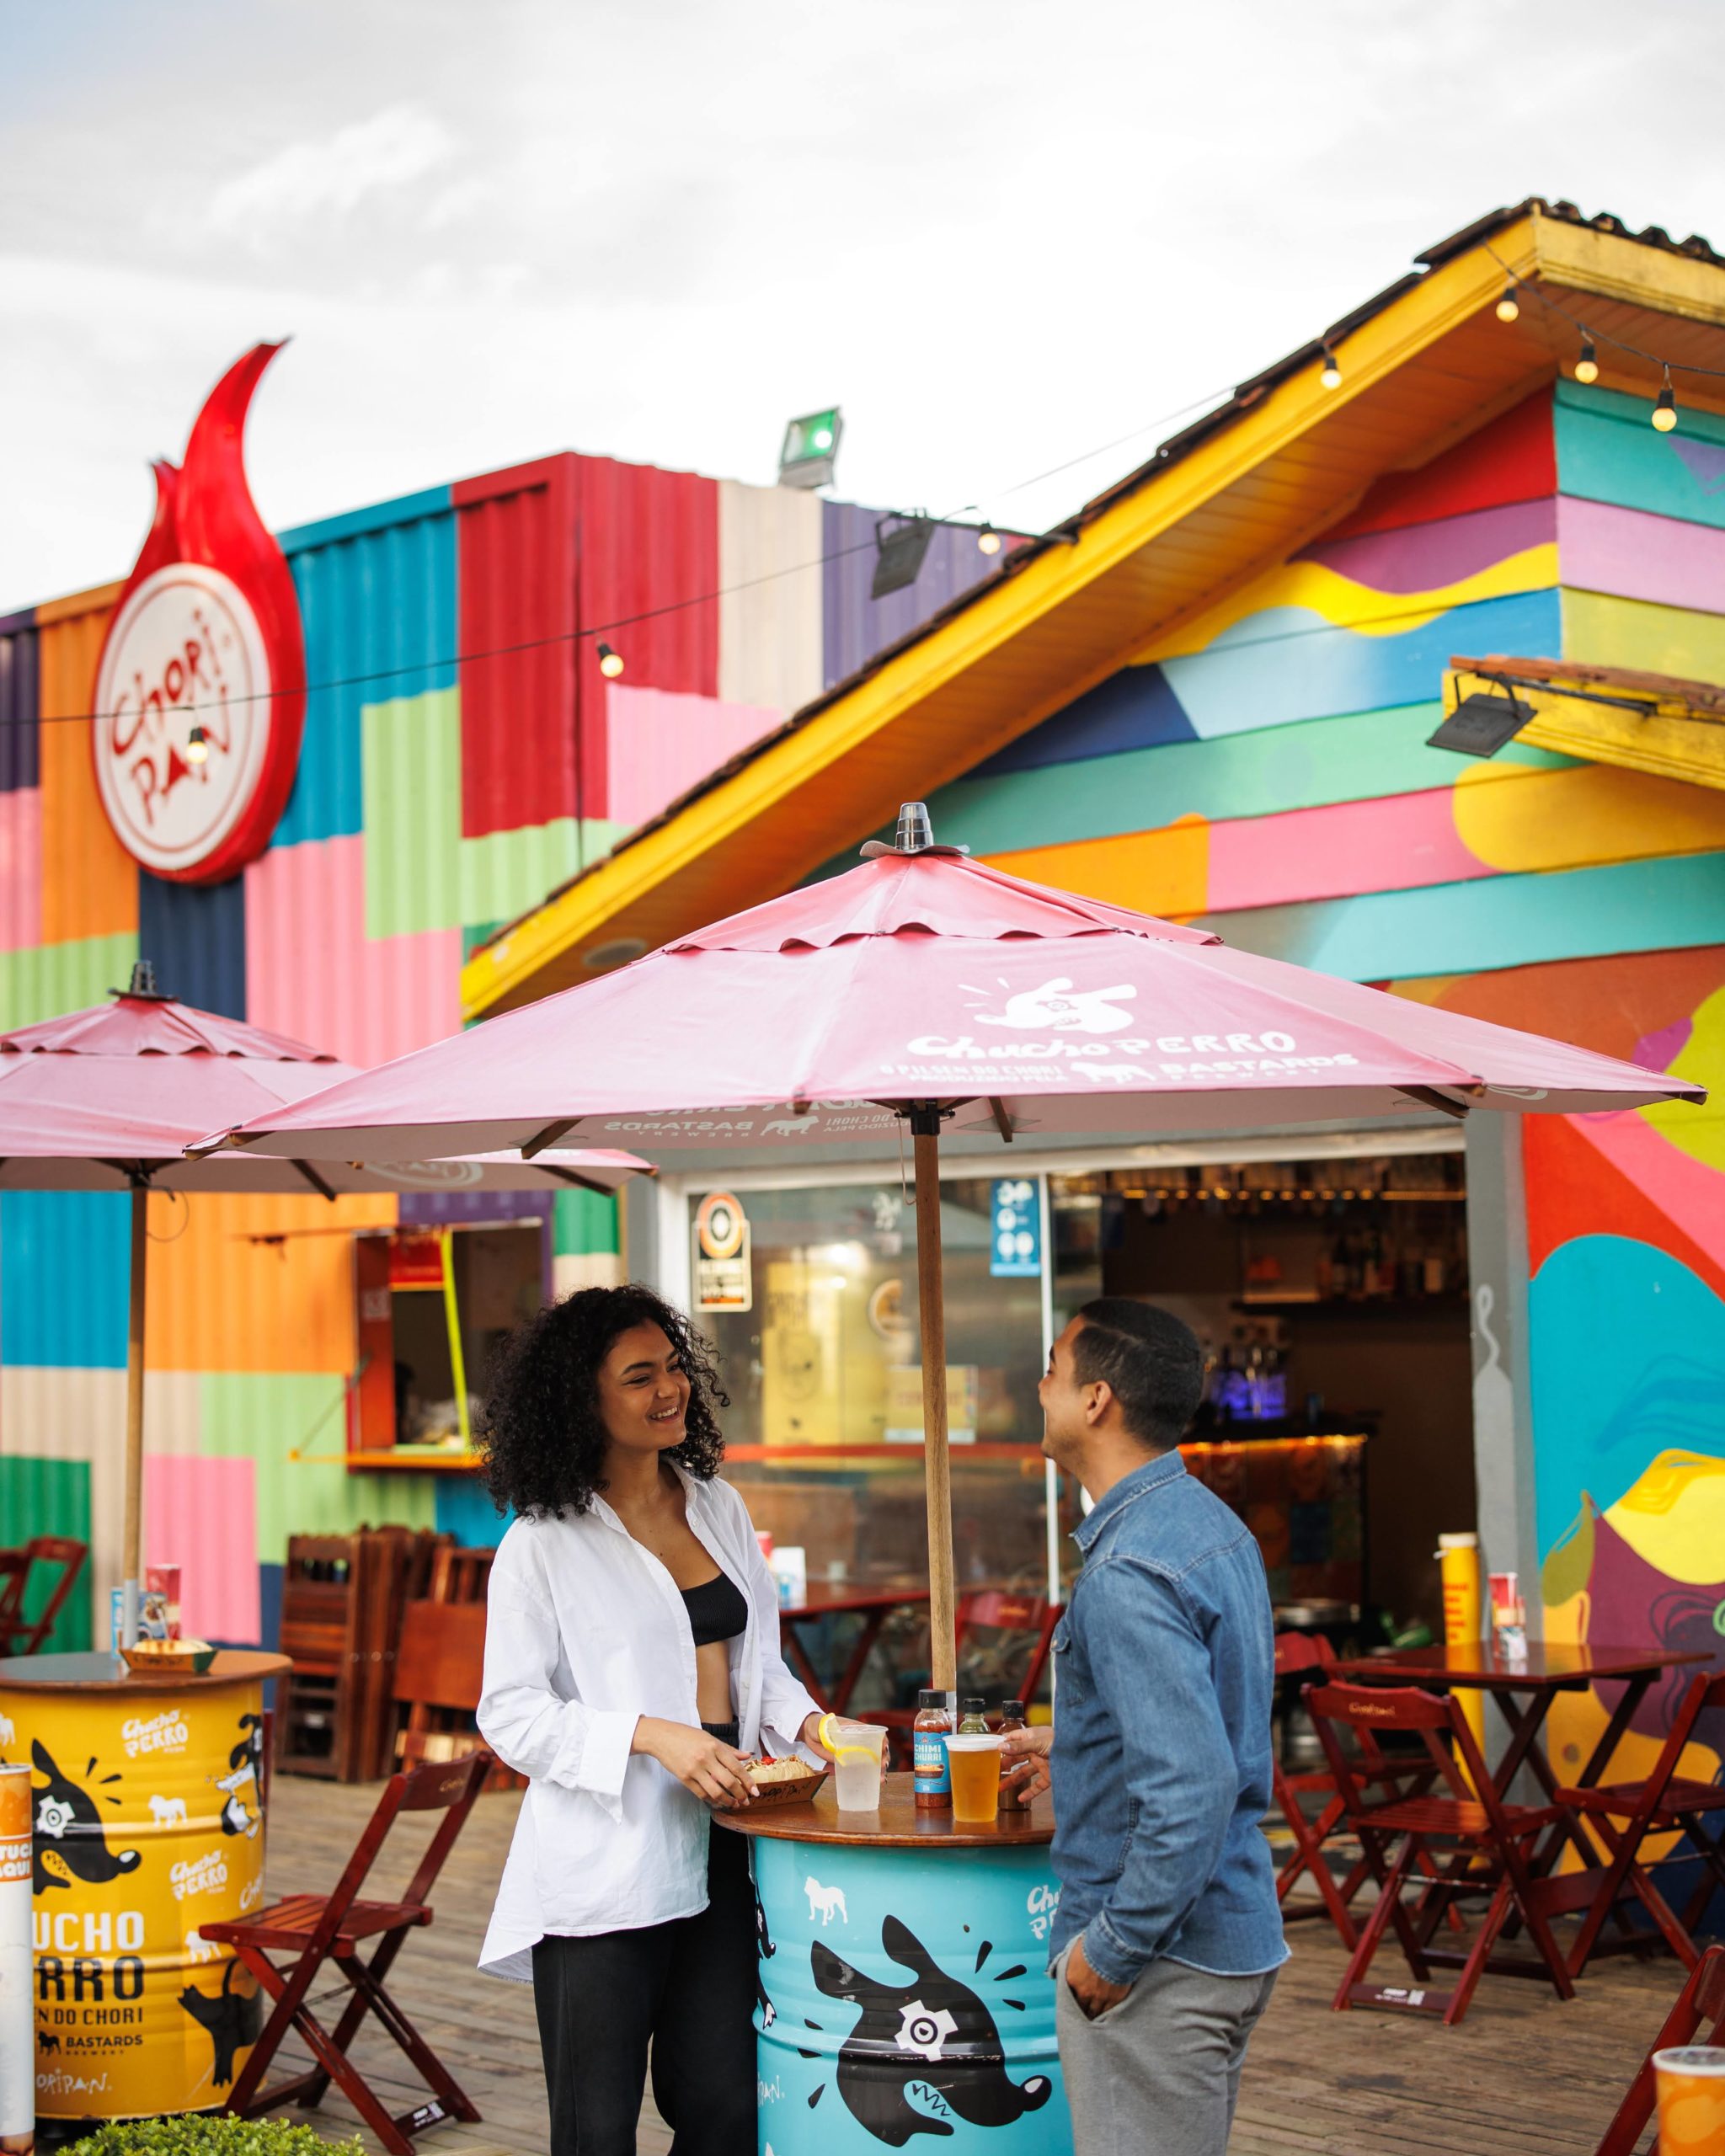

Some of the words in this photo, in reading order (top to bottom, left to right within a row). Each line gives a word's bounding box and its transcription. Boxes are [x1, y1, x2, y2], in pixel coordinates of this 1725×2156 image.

[907, 1036, 1111, 1059] Chucho
[1113, 1031, 1297, 1054] PERRO
[896, 1065, 969, 1075] PILSEN
[971, 1065, 999, 1075] DO
[1002, 1065, 1063, 1075] CHORI
[1158, 1053, 1359, 1074] BASTARDS
[122, 1710, 180, 1740] Chucho
[126, 1723, 189, 1758] PERRO
[915, 1744, 942, 1753] CHIMI
[915, 1753, 942, 1761] CHURRI
[172, 1864, 227, 1901] PERRO
[32, 1911, 144, 1951] UCHO
[39, 1956, 145, 2001] RRO
[54, 2009, 77, 2025] DO
[83, 2007, 143, 2025] CHORI
[67, 2034, 143, 2048] BASTARDS
